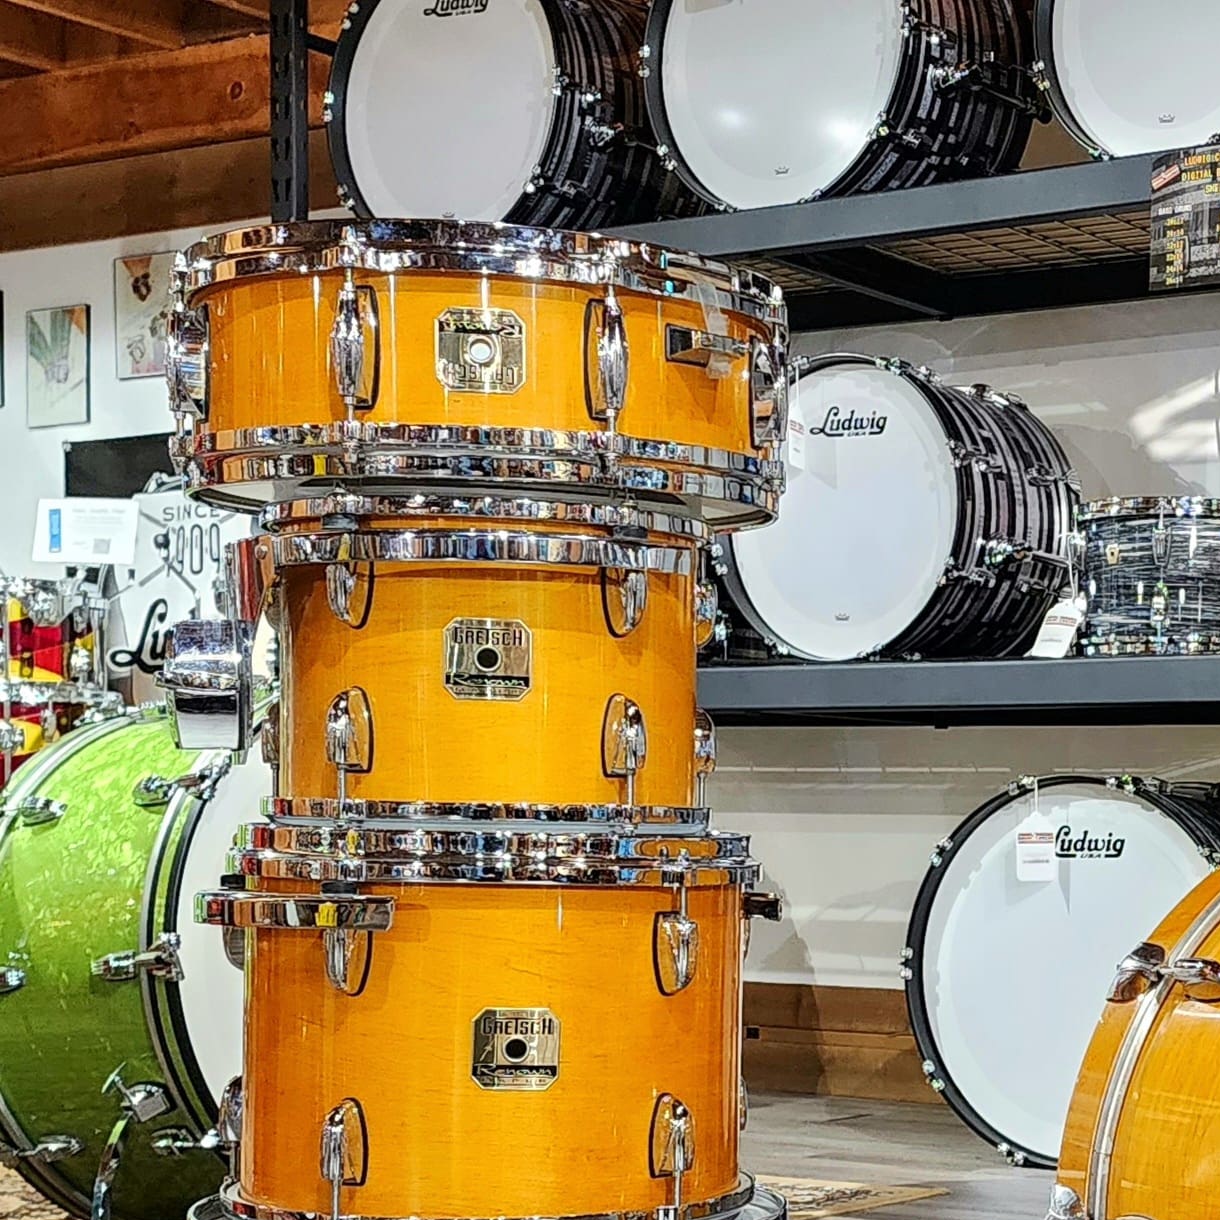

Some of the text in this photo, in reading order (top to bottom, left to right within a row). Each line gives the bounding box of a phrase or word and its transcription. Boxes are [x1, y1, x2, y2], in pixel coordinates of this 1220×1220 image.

[809, 406, 888, 437] Ludwig
[163, 504, 220, 522] SINCE
[454, 626, 523, 646] GRETSCH
[1055, 825, 1126, 858] Ludwig
[482, 1016, 554, 1035] GRETSCH
